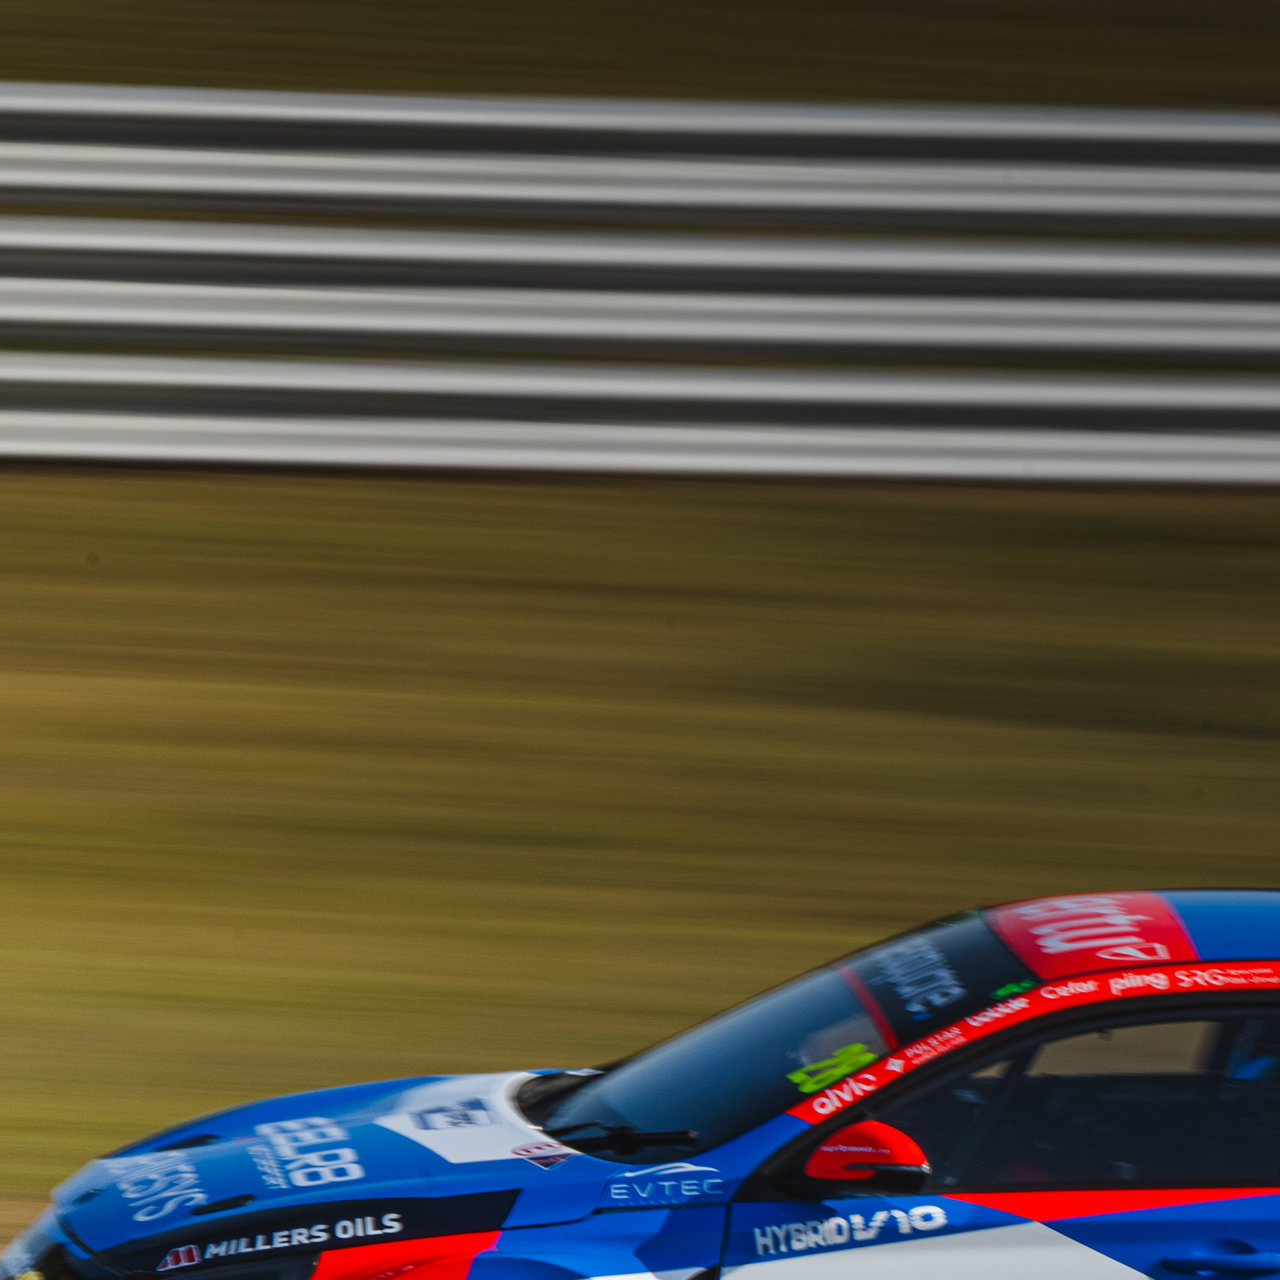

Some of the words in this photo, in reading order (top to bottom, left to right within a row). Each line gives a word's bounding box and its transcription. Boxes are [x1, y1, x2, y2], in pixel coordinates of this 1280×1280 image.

[610, 1179, 724, 1199] EVTEC
[203, 1223, 331, 1260] MILLERS
[334, 1212, 404, 1240] OILS
[753, 1216, 851, 1255] HYBRID
